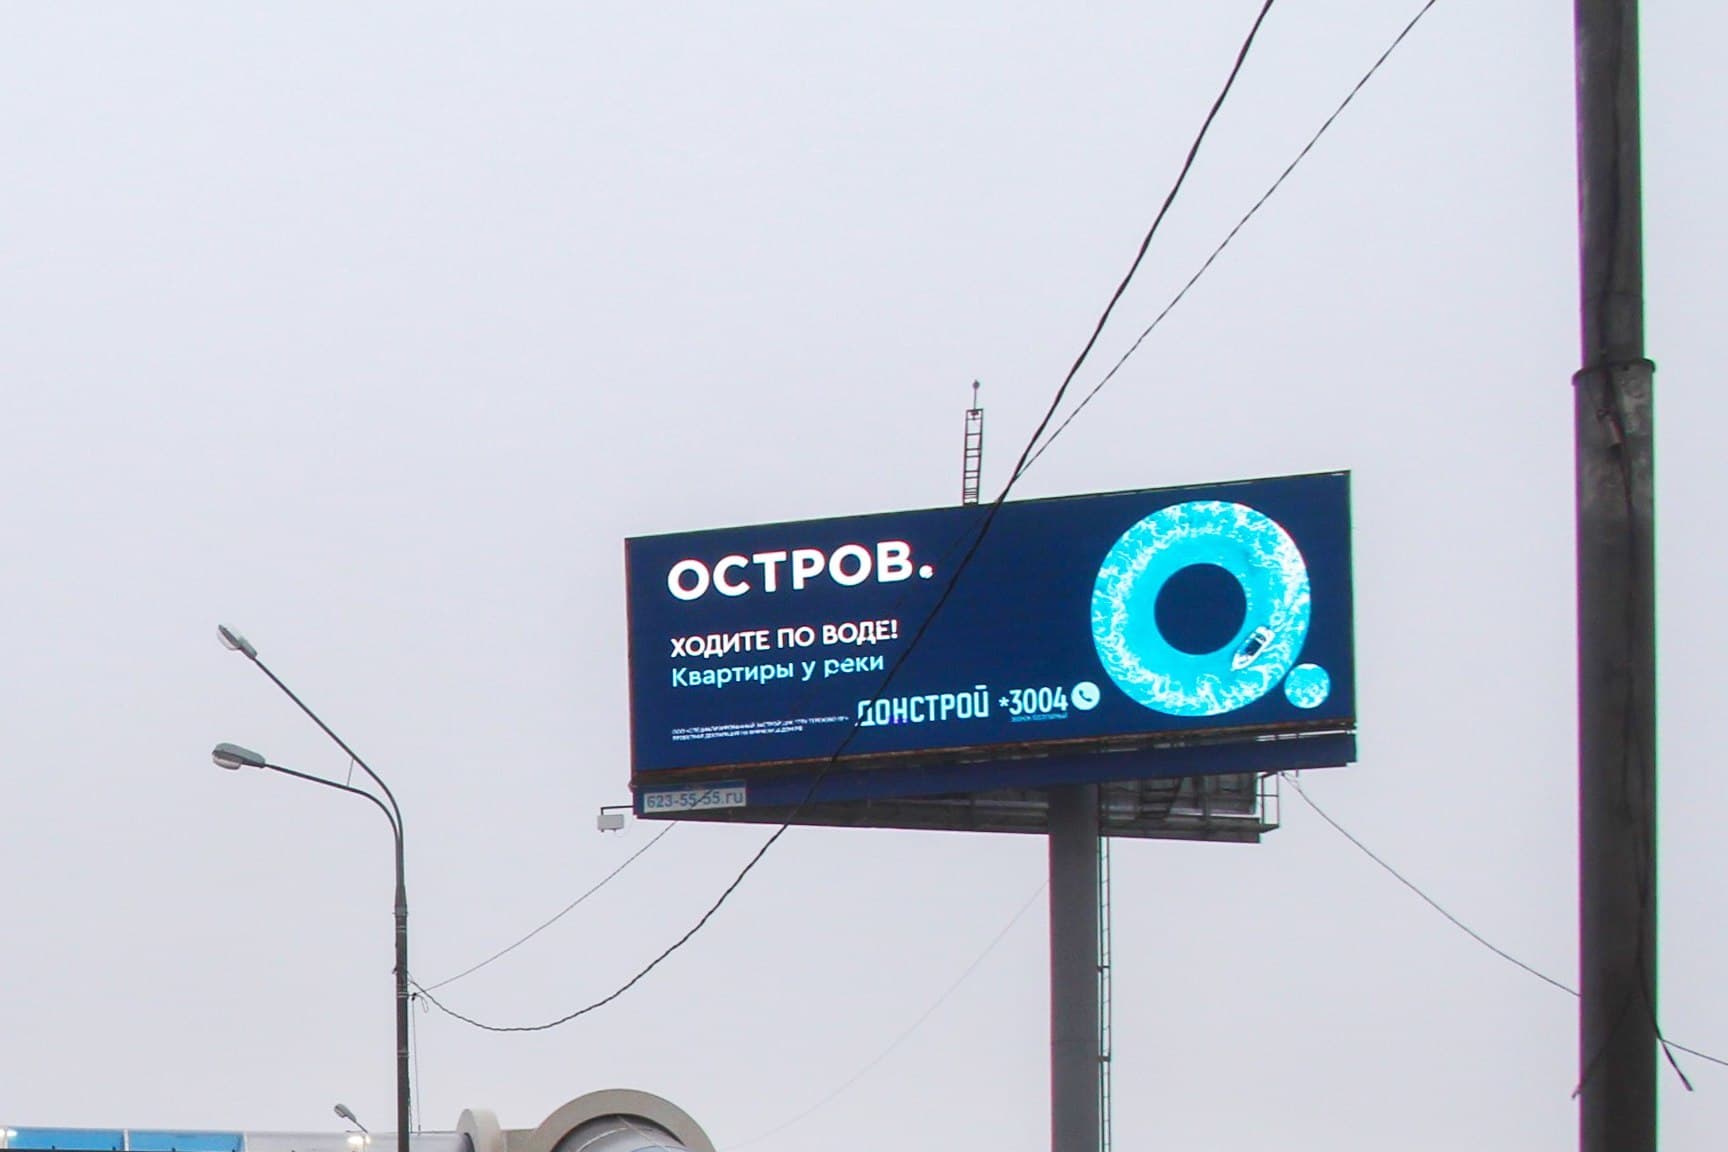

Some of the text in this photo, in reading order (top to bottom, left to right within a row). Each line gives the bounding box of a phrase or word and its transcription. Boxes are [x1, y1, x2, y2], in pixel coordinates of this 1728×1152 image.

[667, 540, 935, 601] ОСТРОВ.
[670, 619, 899, 659] ХОДИТЕ ПО ВОДЕ!
[672, 655, 884, 688] Квартиры у реки
[854, 684, 990, 727] ДОНСТРОЙ
[646, 789, 744, 809] 623-55-55.ru
